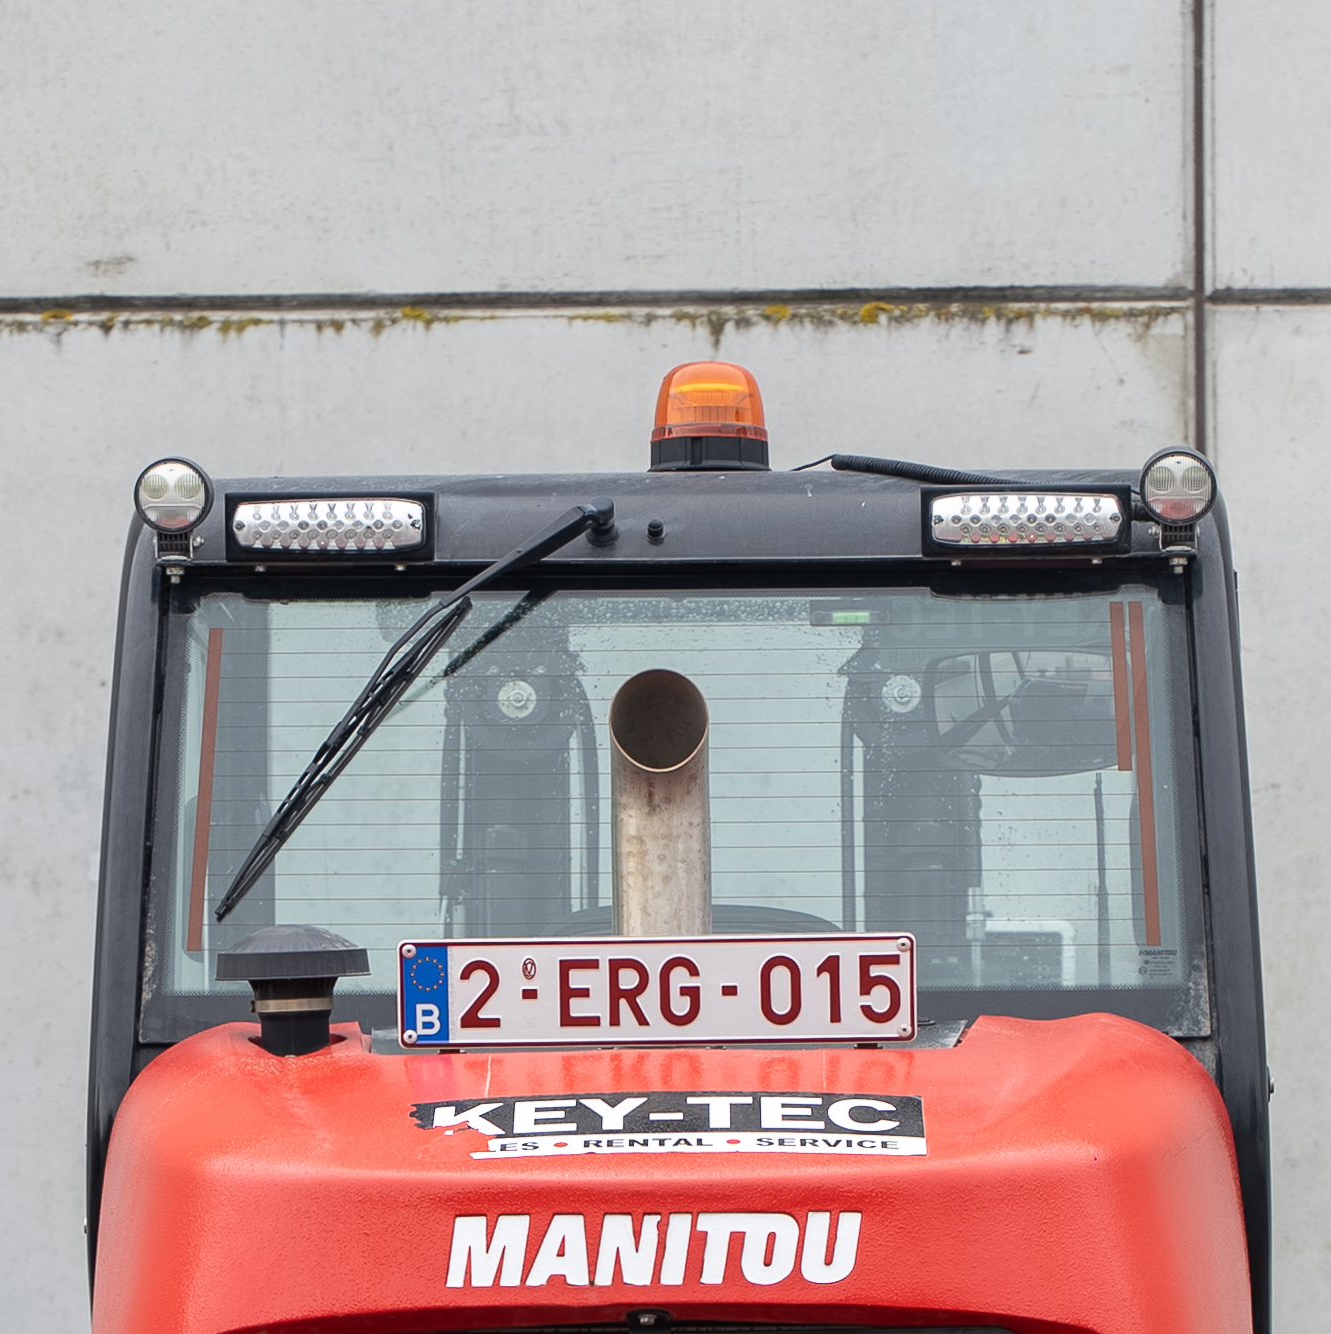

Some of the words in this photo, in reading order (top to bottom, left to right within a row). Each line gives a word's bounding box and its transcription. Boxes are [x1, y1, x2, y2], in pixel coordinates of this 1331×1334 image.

[415, 1003, 441, 1036] B
[433, 1097, 901, 1135] KEY-TEC
[583, 1137, 714, 1148] RENTAL
[756, 1137, 900, 1150] SERVICE
[446, 1210, 863, 1288] MANITOU
